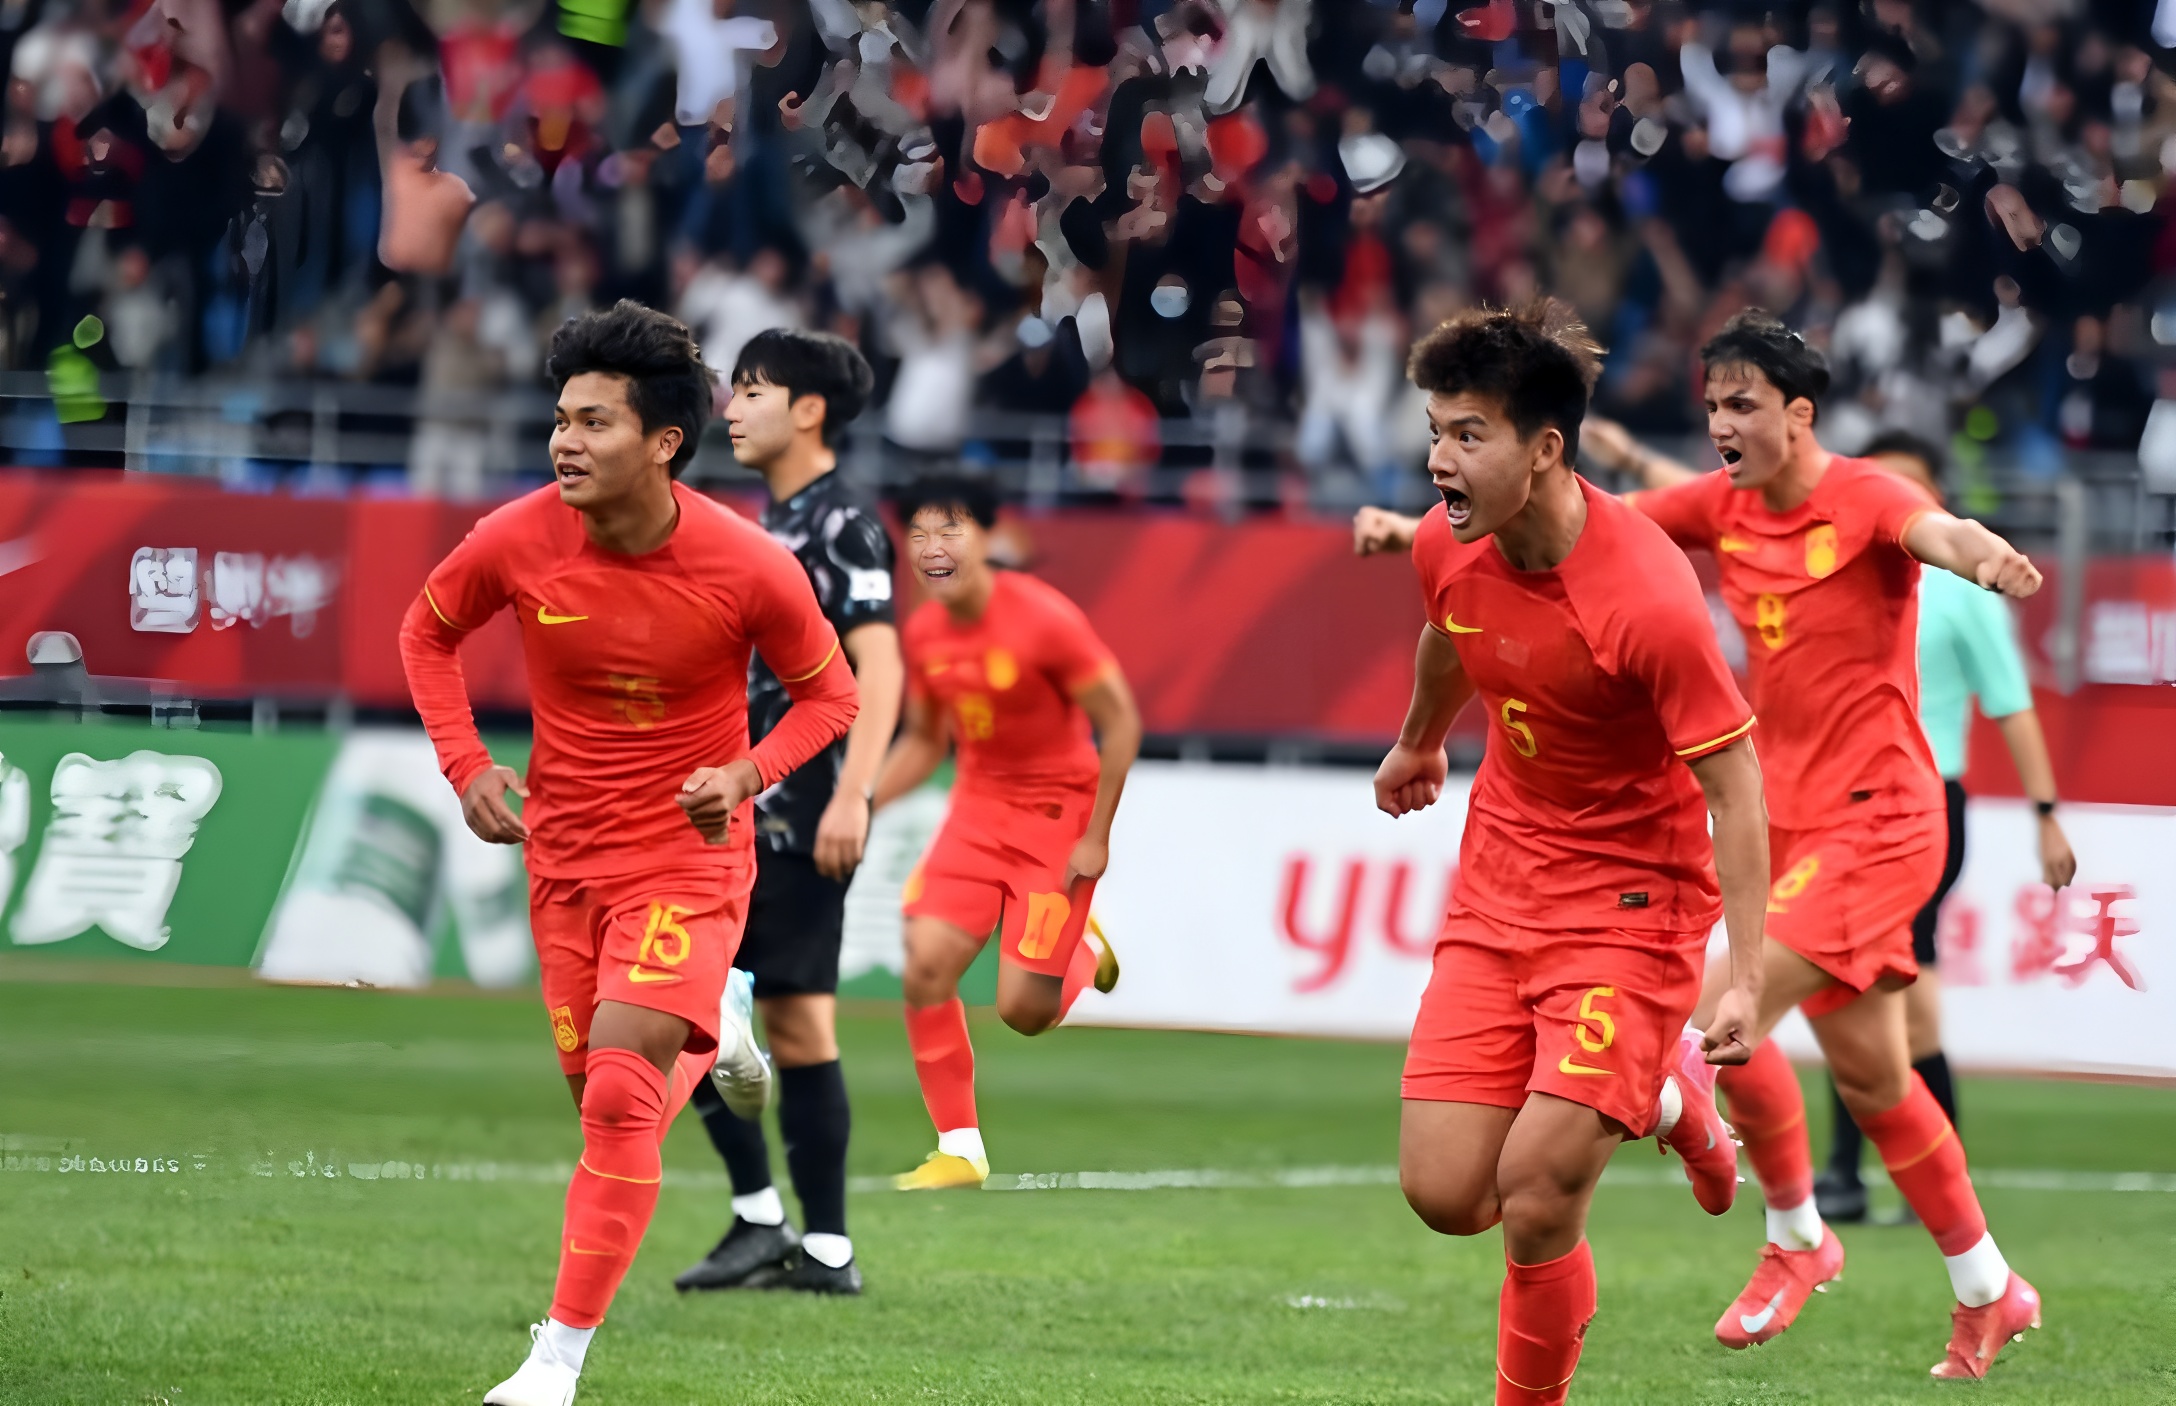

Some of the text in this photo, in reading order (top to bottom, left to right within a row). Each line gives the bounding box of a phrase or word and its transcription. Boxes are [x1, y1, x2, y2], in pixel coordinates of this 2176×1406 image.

[1756, 593, 1785, 650] 8
[1501, 697, 1538, 758] 5
[1771, 855, 1820, 899] 8
[638, 899, 691, 967] 15
[1575, 986, 1616, 1053] 5
